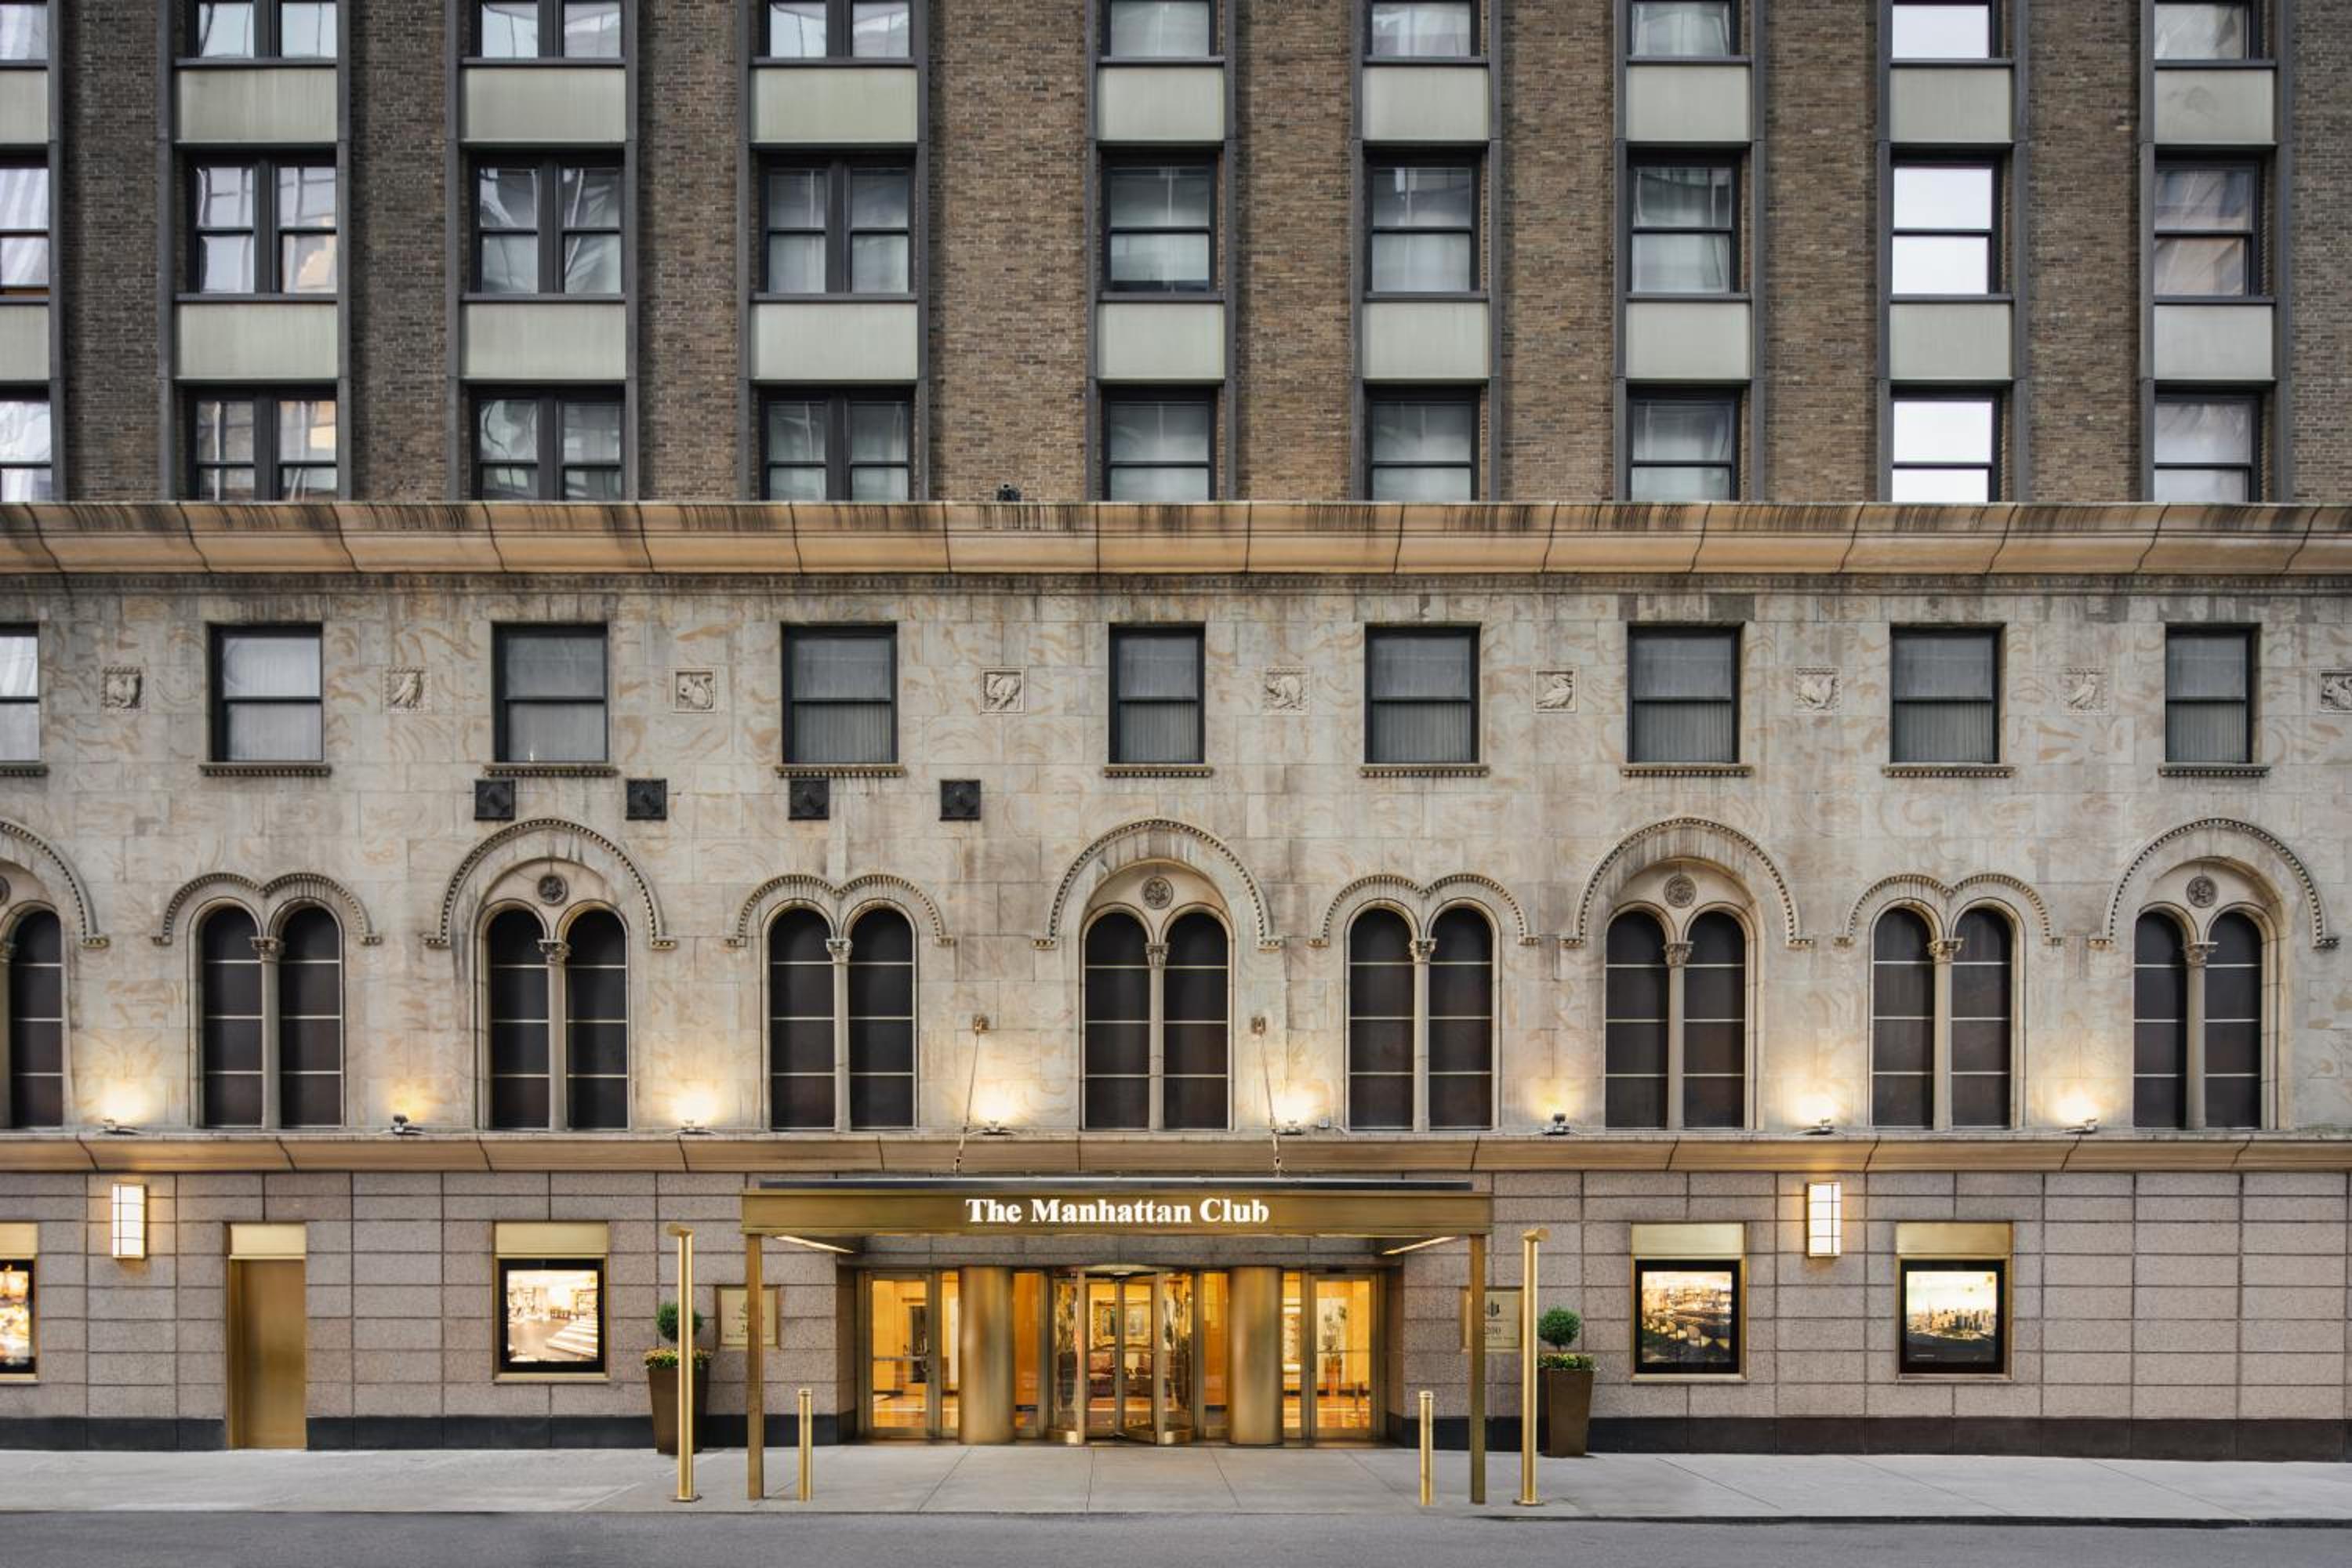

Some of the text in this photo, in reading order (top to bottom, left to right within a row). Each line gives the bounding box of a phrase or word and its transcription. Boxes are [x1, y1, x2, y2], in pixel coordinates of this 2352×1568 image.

[966, 1198, 1269, 1222] The Manhattan Club
